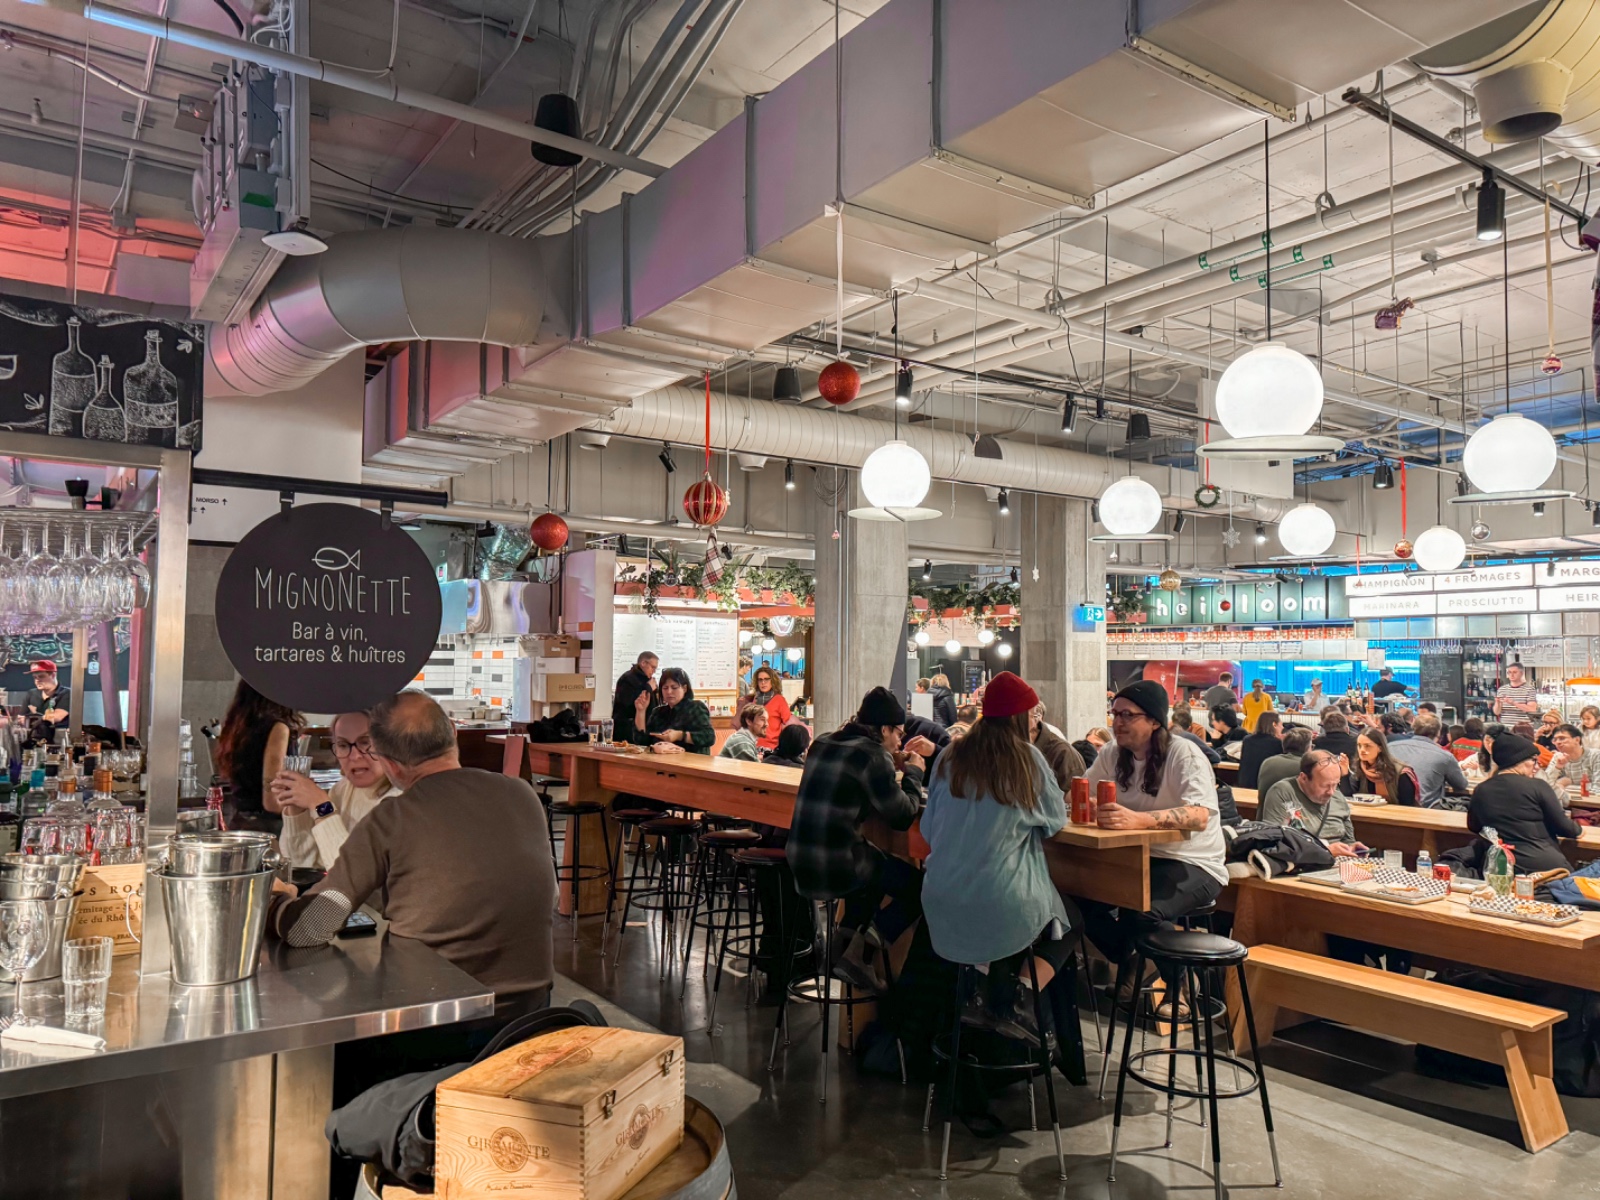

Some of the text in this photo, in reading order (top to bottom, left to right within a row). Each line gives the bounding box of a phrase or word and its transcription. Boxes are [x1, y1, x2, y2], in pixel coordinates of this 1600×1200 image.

[1444, 572, 1521, 584] 4 FROMAGES
[255, 567, 411, 616] MIGNONETTE
[1449, 596, 1524, 607] PROSCIUTTO
[1566, 593, 1599, 602] HEIR
[1363, 601, 1420, 610] MARINARA
[292, 621, 368, 643] Bar à vin,
[254, 645, 406, 663] tartares & huîtres
[106, 914, 135, 923] Rhôe
